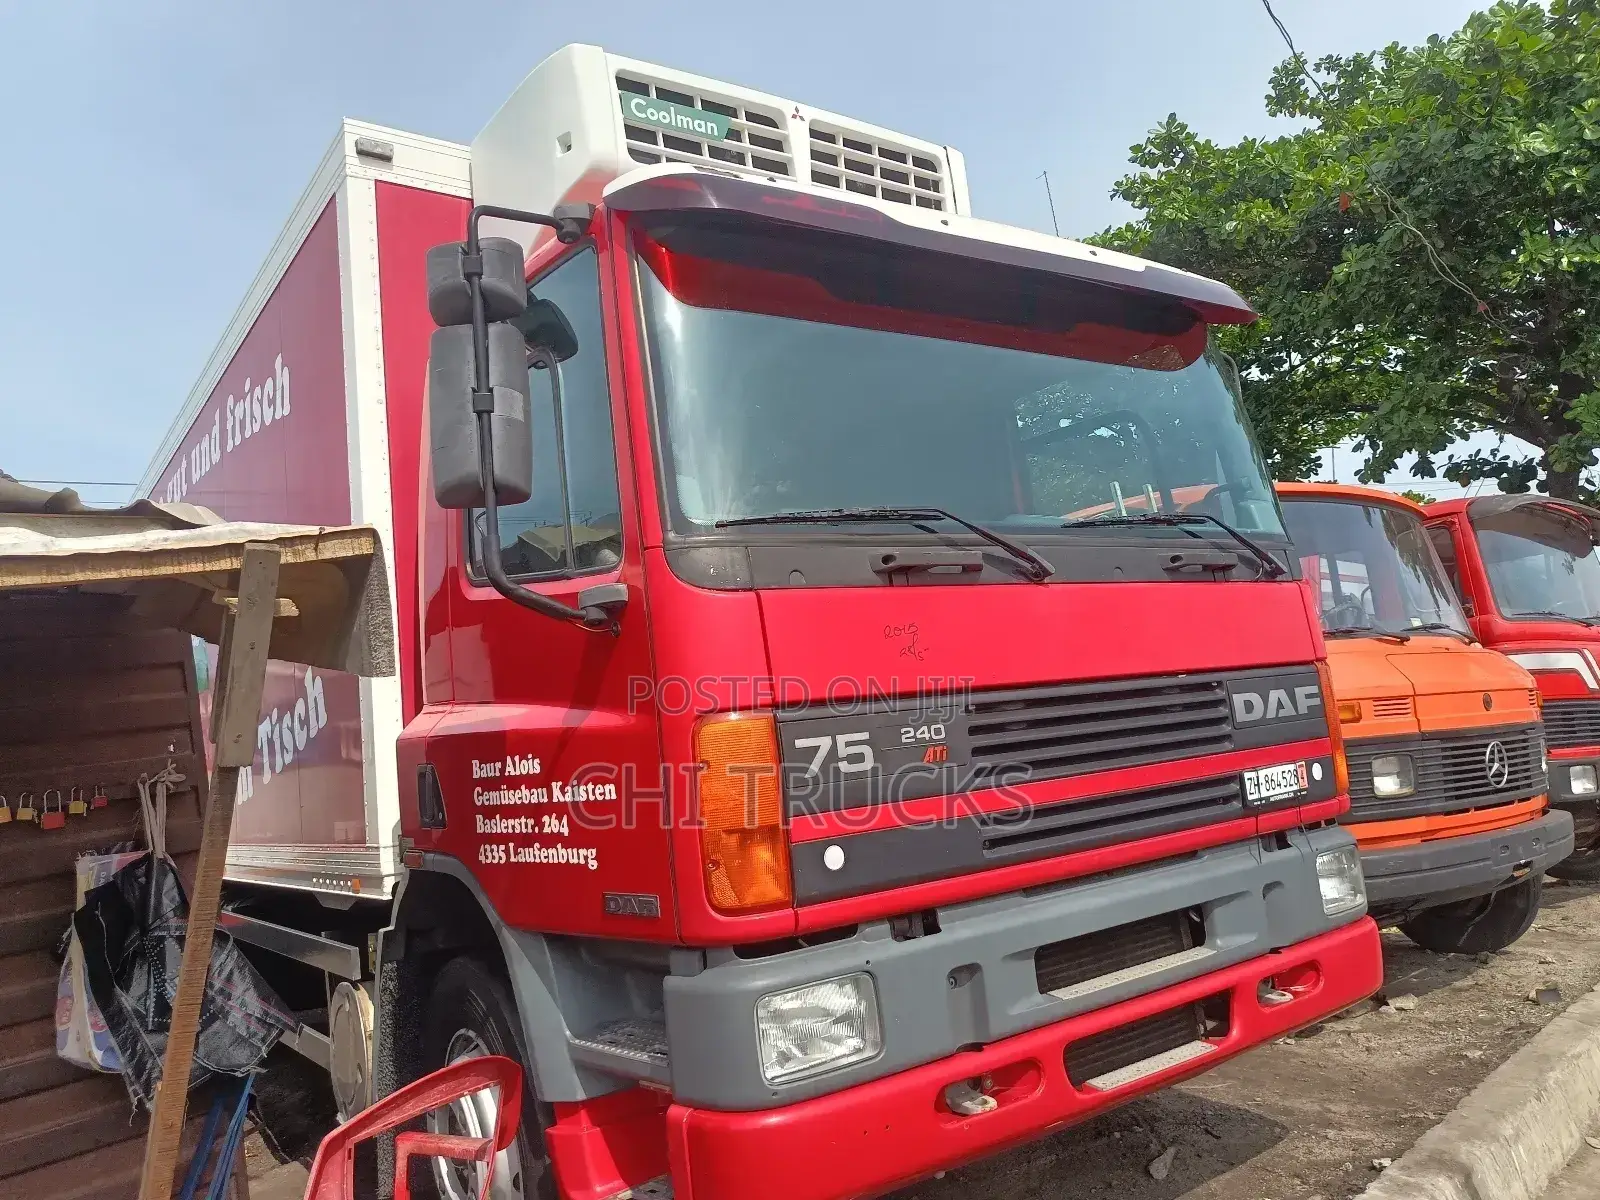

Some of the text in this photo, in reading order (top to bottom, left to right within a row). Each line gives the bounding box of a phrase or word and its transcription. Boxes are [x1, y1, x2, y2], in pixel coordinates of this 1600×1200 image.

[630, 97, 719, 137] Coolman
[190, 407, 222, 485] und
[226, 352, 291, 453] frisch
[1232, 685, 1321, 722] DAF
[257, 665, 328, 785] Tisch
[900, 724, 946, 743] 240
[471, 753, 541, 779] Baur Alois
[794, 731, 875, 779] 75
[473, 779, 617, 806] Gemüsebau Kaisten
[475, 812, 569, 837] Baslerstr. 264
[478, 842, 598, 871] 4335 Laufenburg
